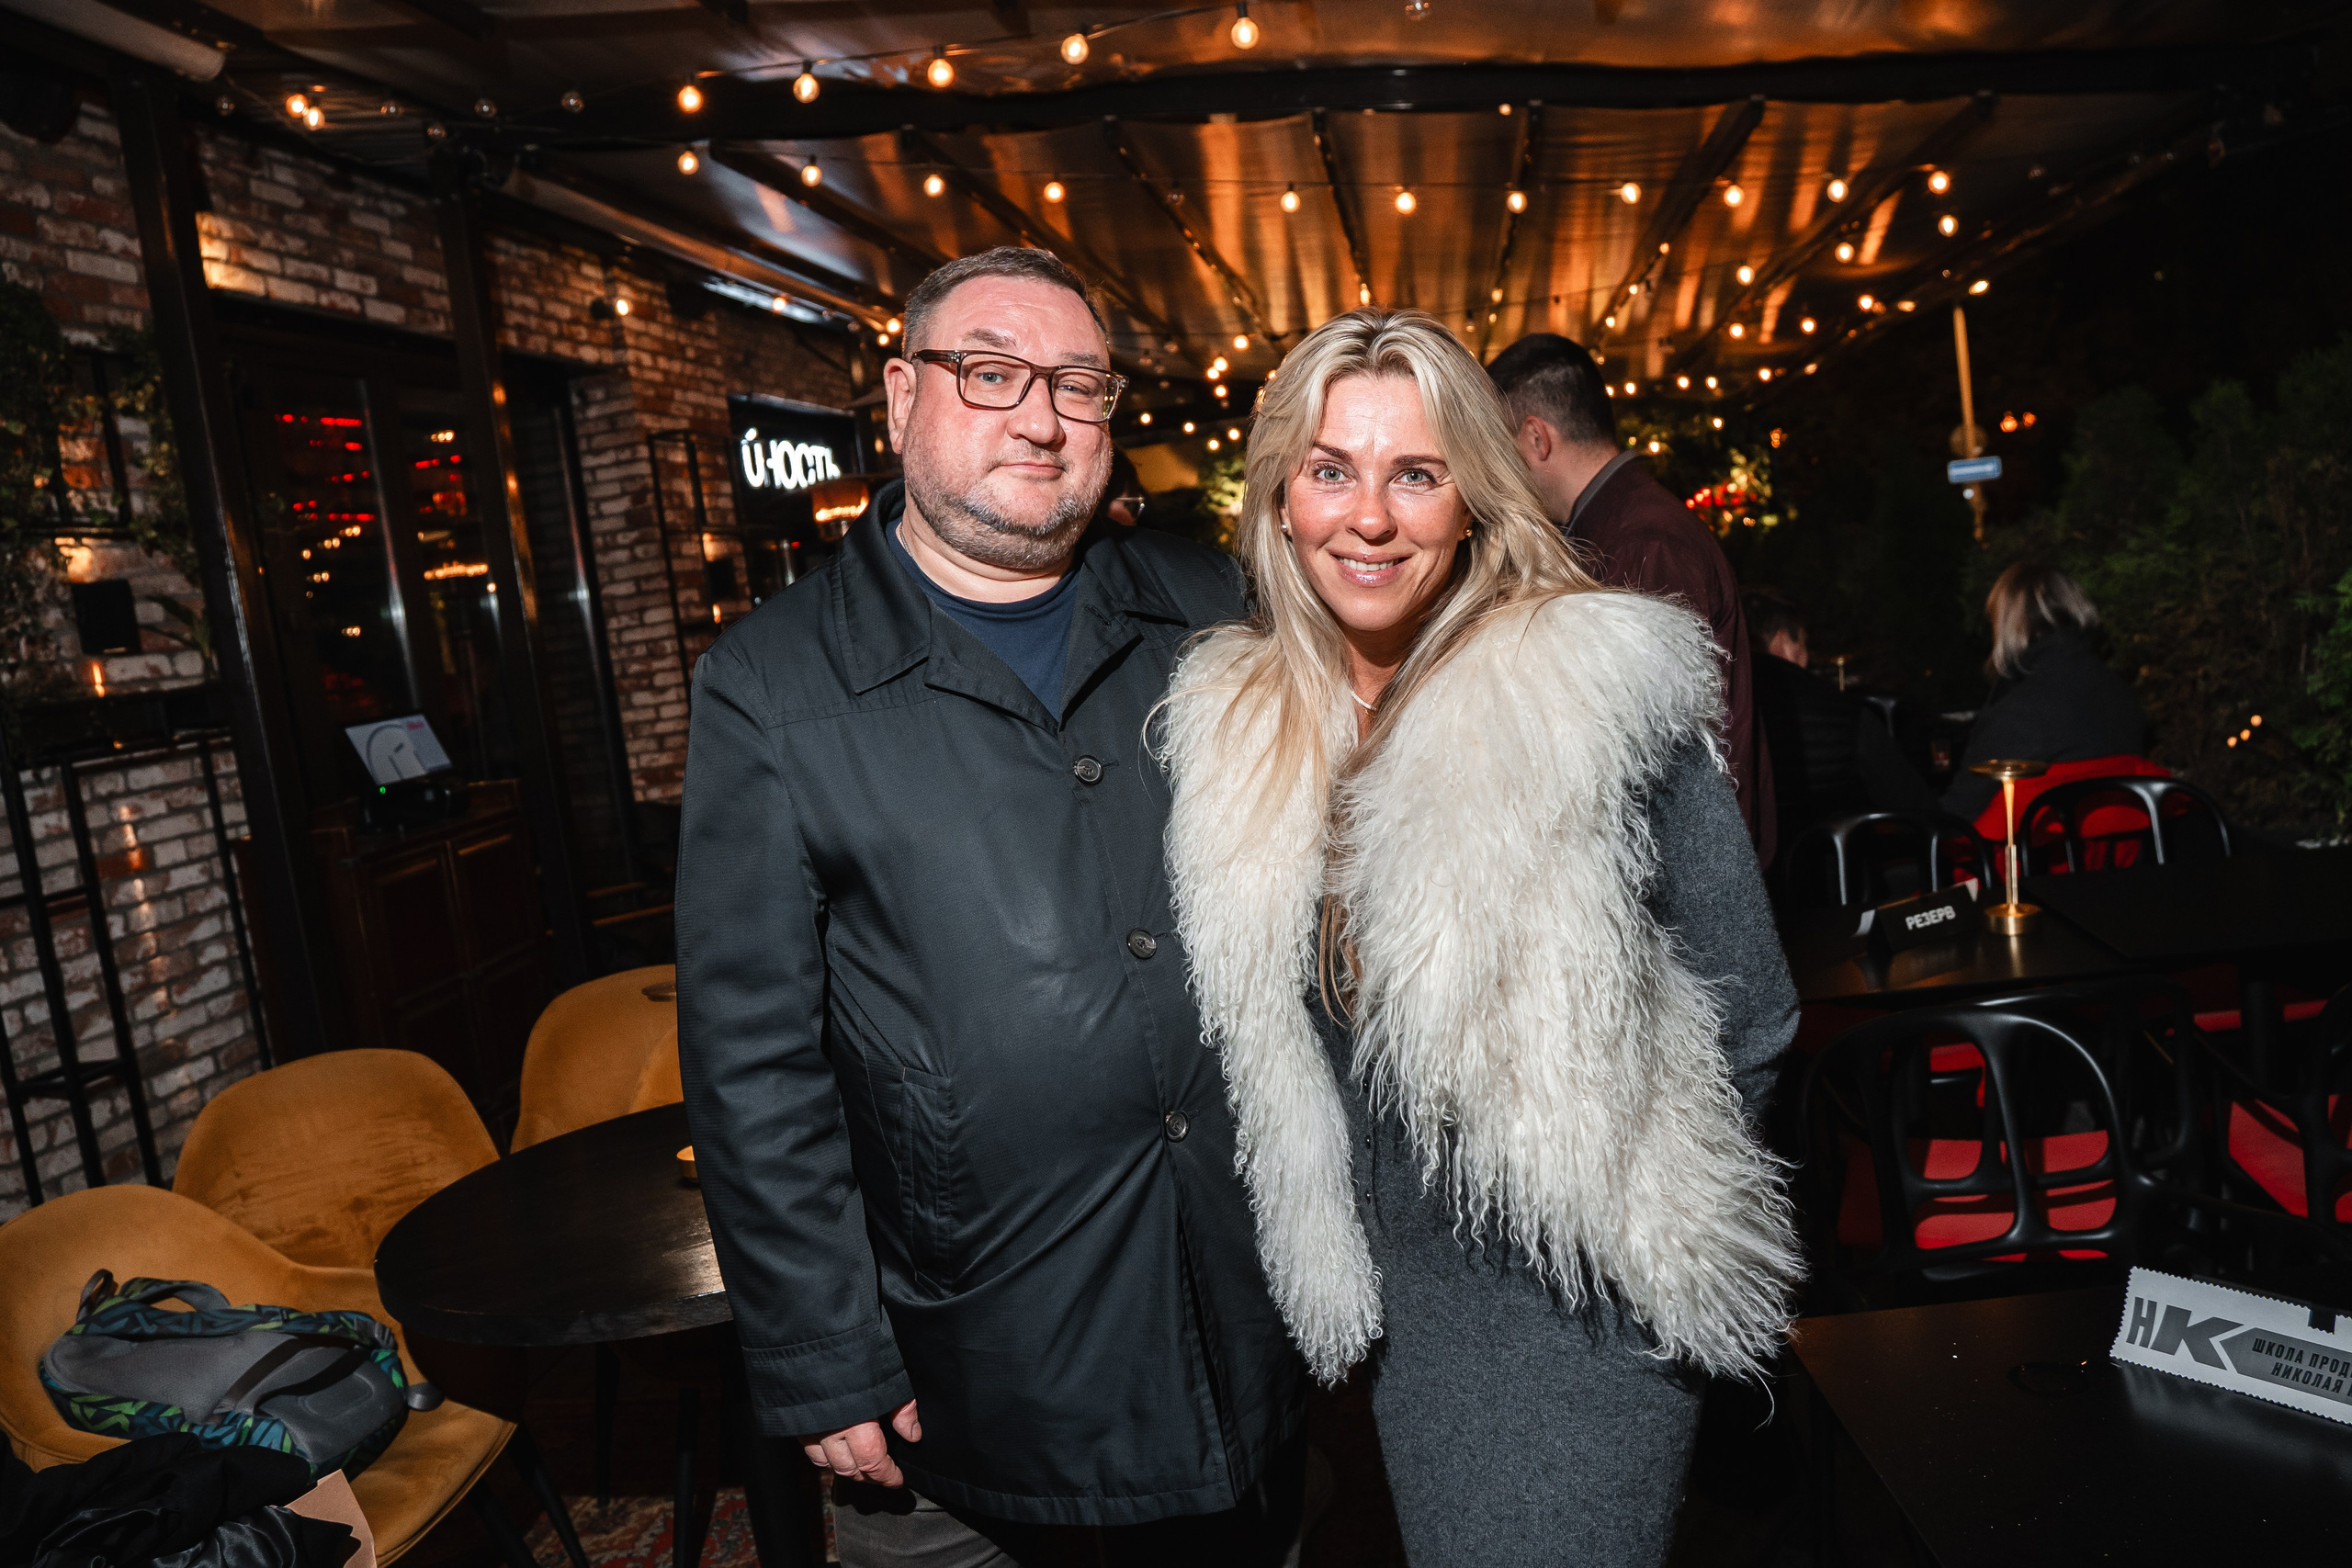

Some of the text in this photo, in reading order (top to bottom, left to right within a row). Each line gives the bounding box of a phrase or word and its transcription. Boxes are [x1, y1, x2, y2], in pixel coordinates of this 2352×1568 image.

[1905, 905, 1957, 931] РЕЗЕРВ
[2251, 1337, 2352, 1379] ШКОЛА ПРОД
[2271, 1362, 2345, 1393] НИКОЛАЯ
